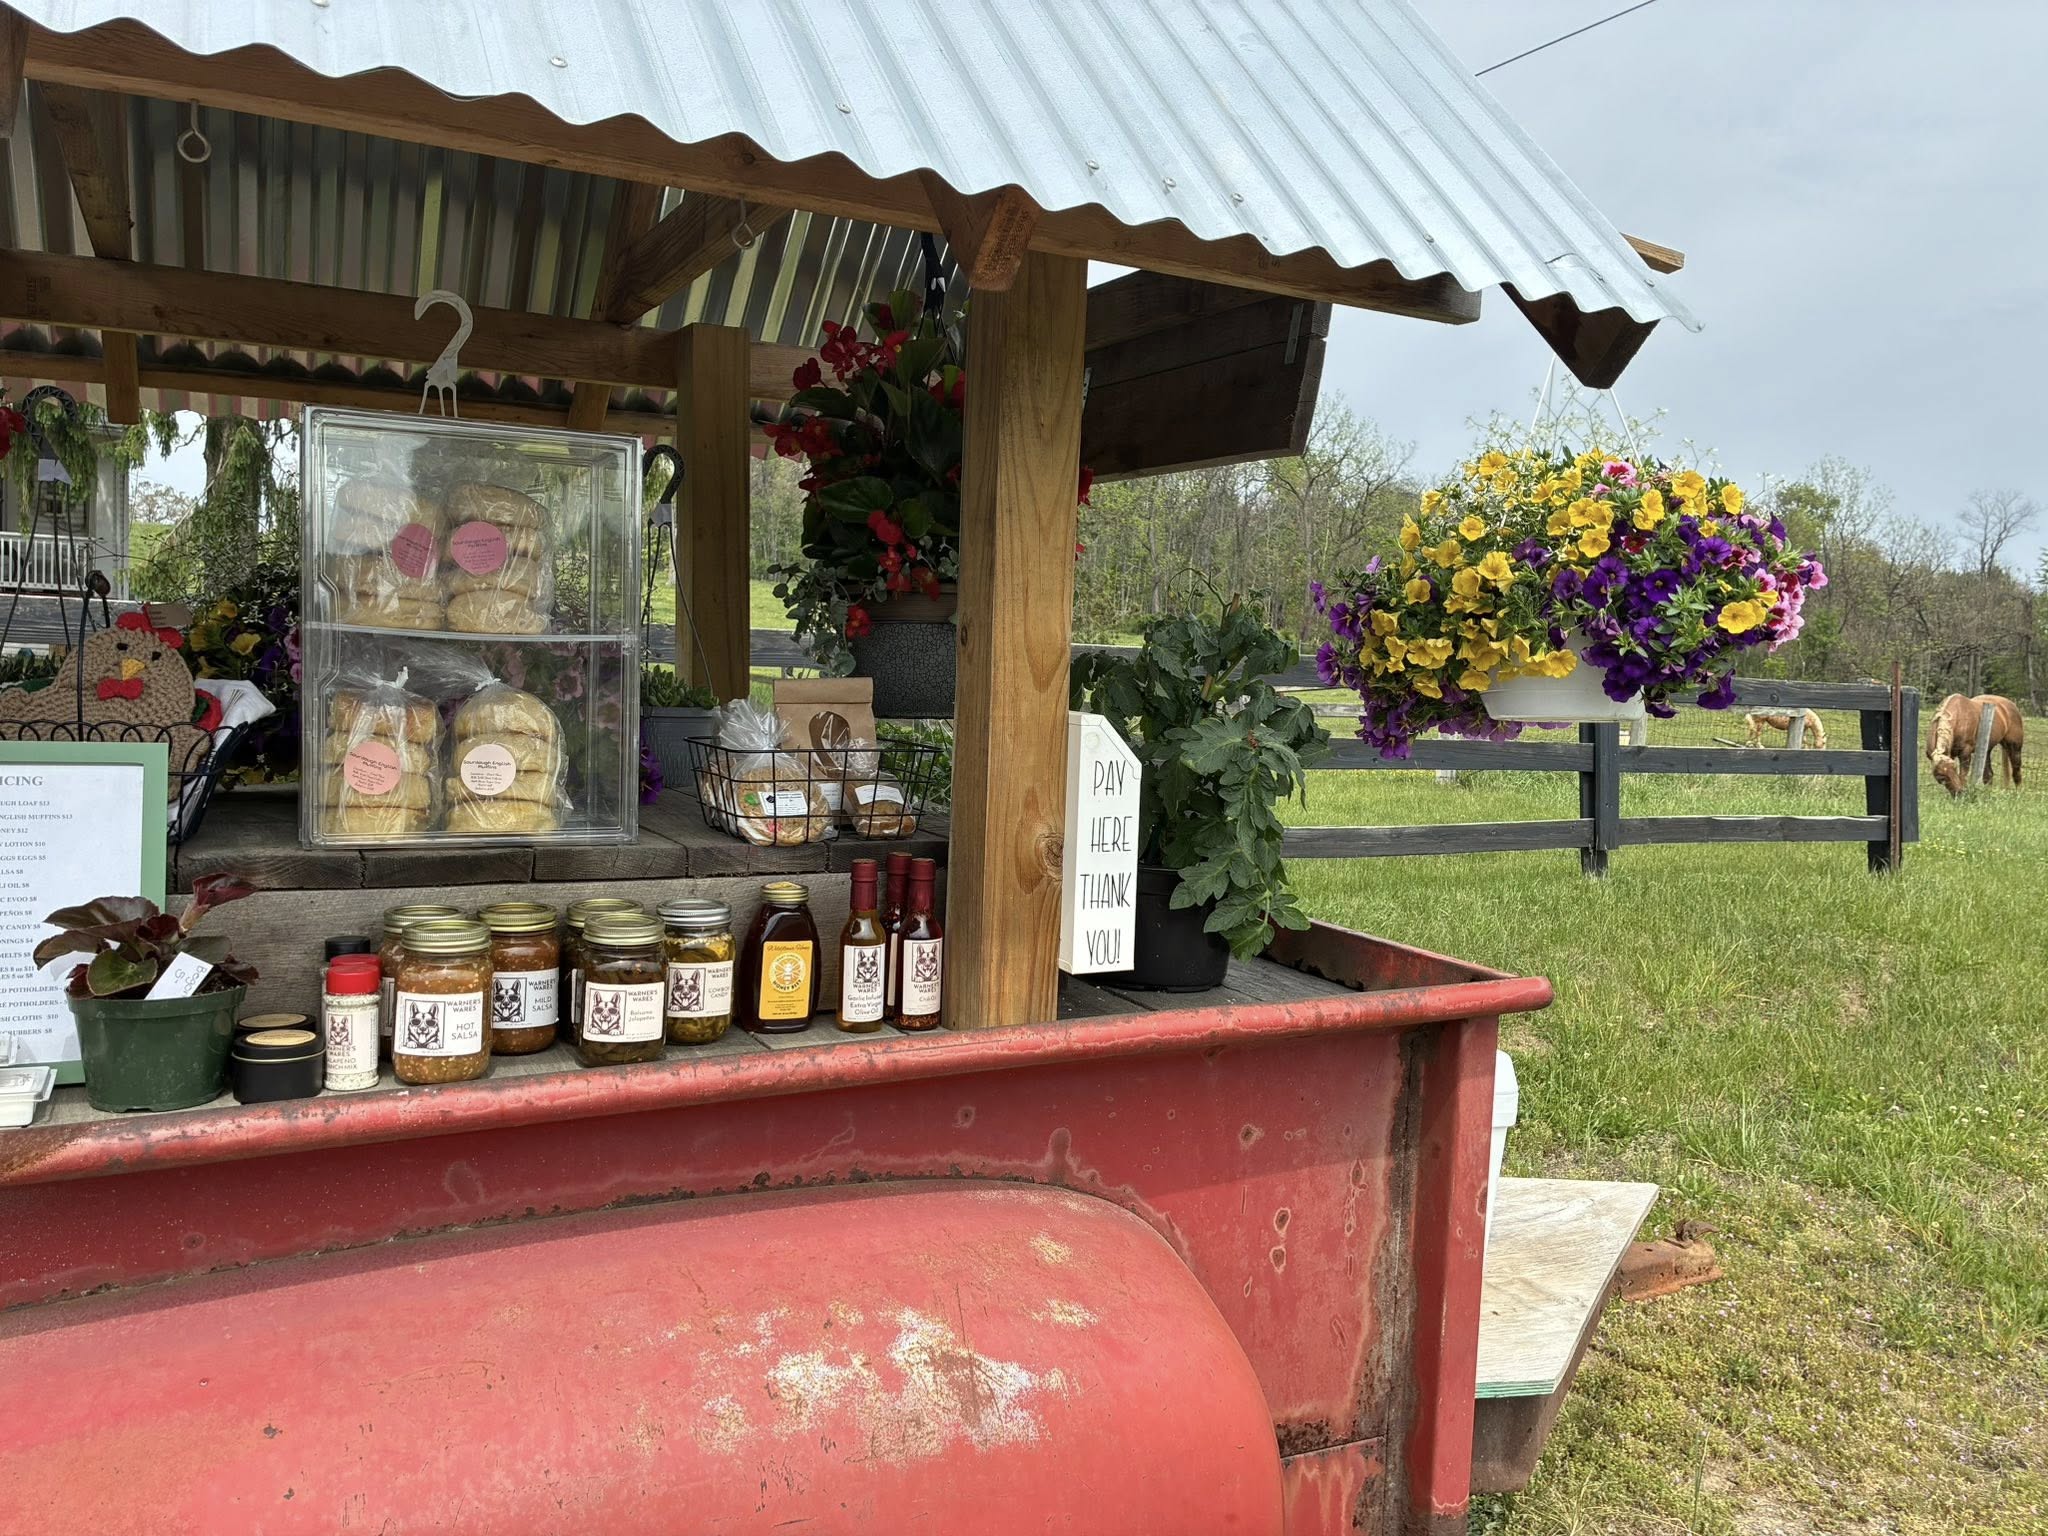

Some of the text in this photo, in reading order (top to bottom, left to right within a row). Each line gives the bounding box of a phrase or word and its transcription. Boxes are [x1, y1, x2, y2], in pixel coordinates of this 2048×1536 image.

[1093, 759, 1127, 796] PAY
[1090, 816, 1133, 853] HERE
[1080, 872, 1132, 910] THANK
[1086, 928, 1121, 966] YOU!
[534, 995, 552, 1004] MILD
[453, 1005, 477, 1013] WARES
[532, 1003, 553, 1012] SALSA
[456, 1021, 475, 1031] HOT
[451, 1030, 478, 1040] SALSA
